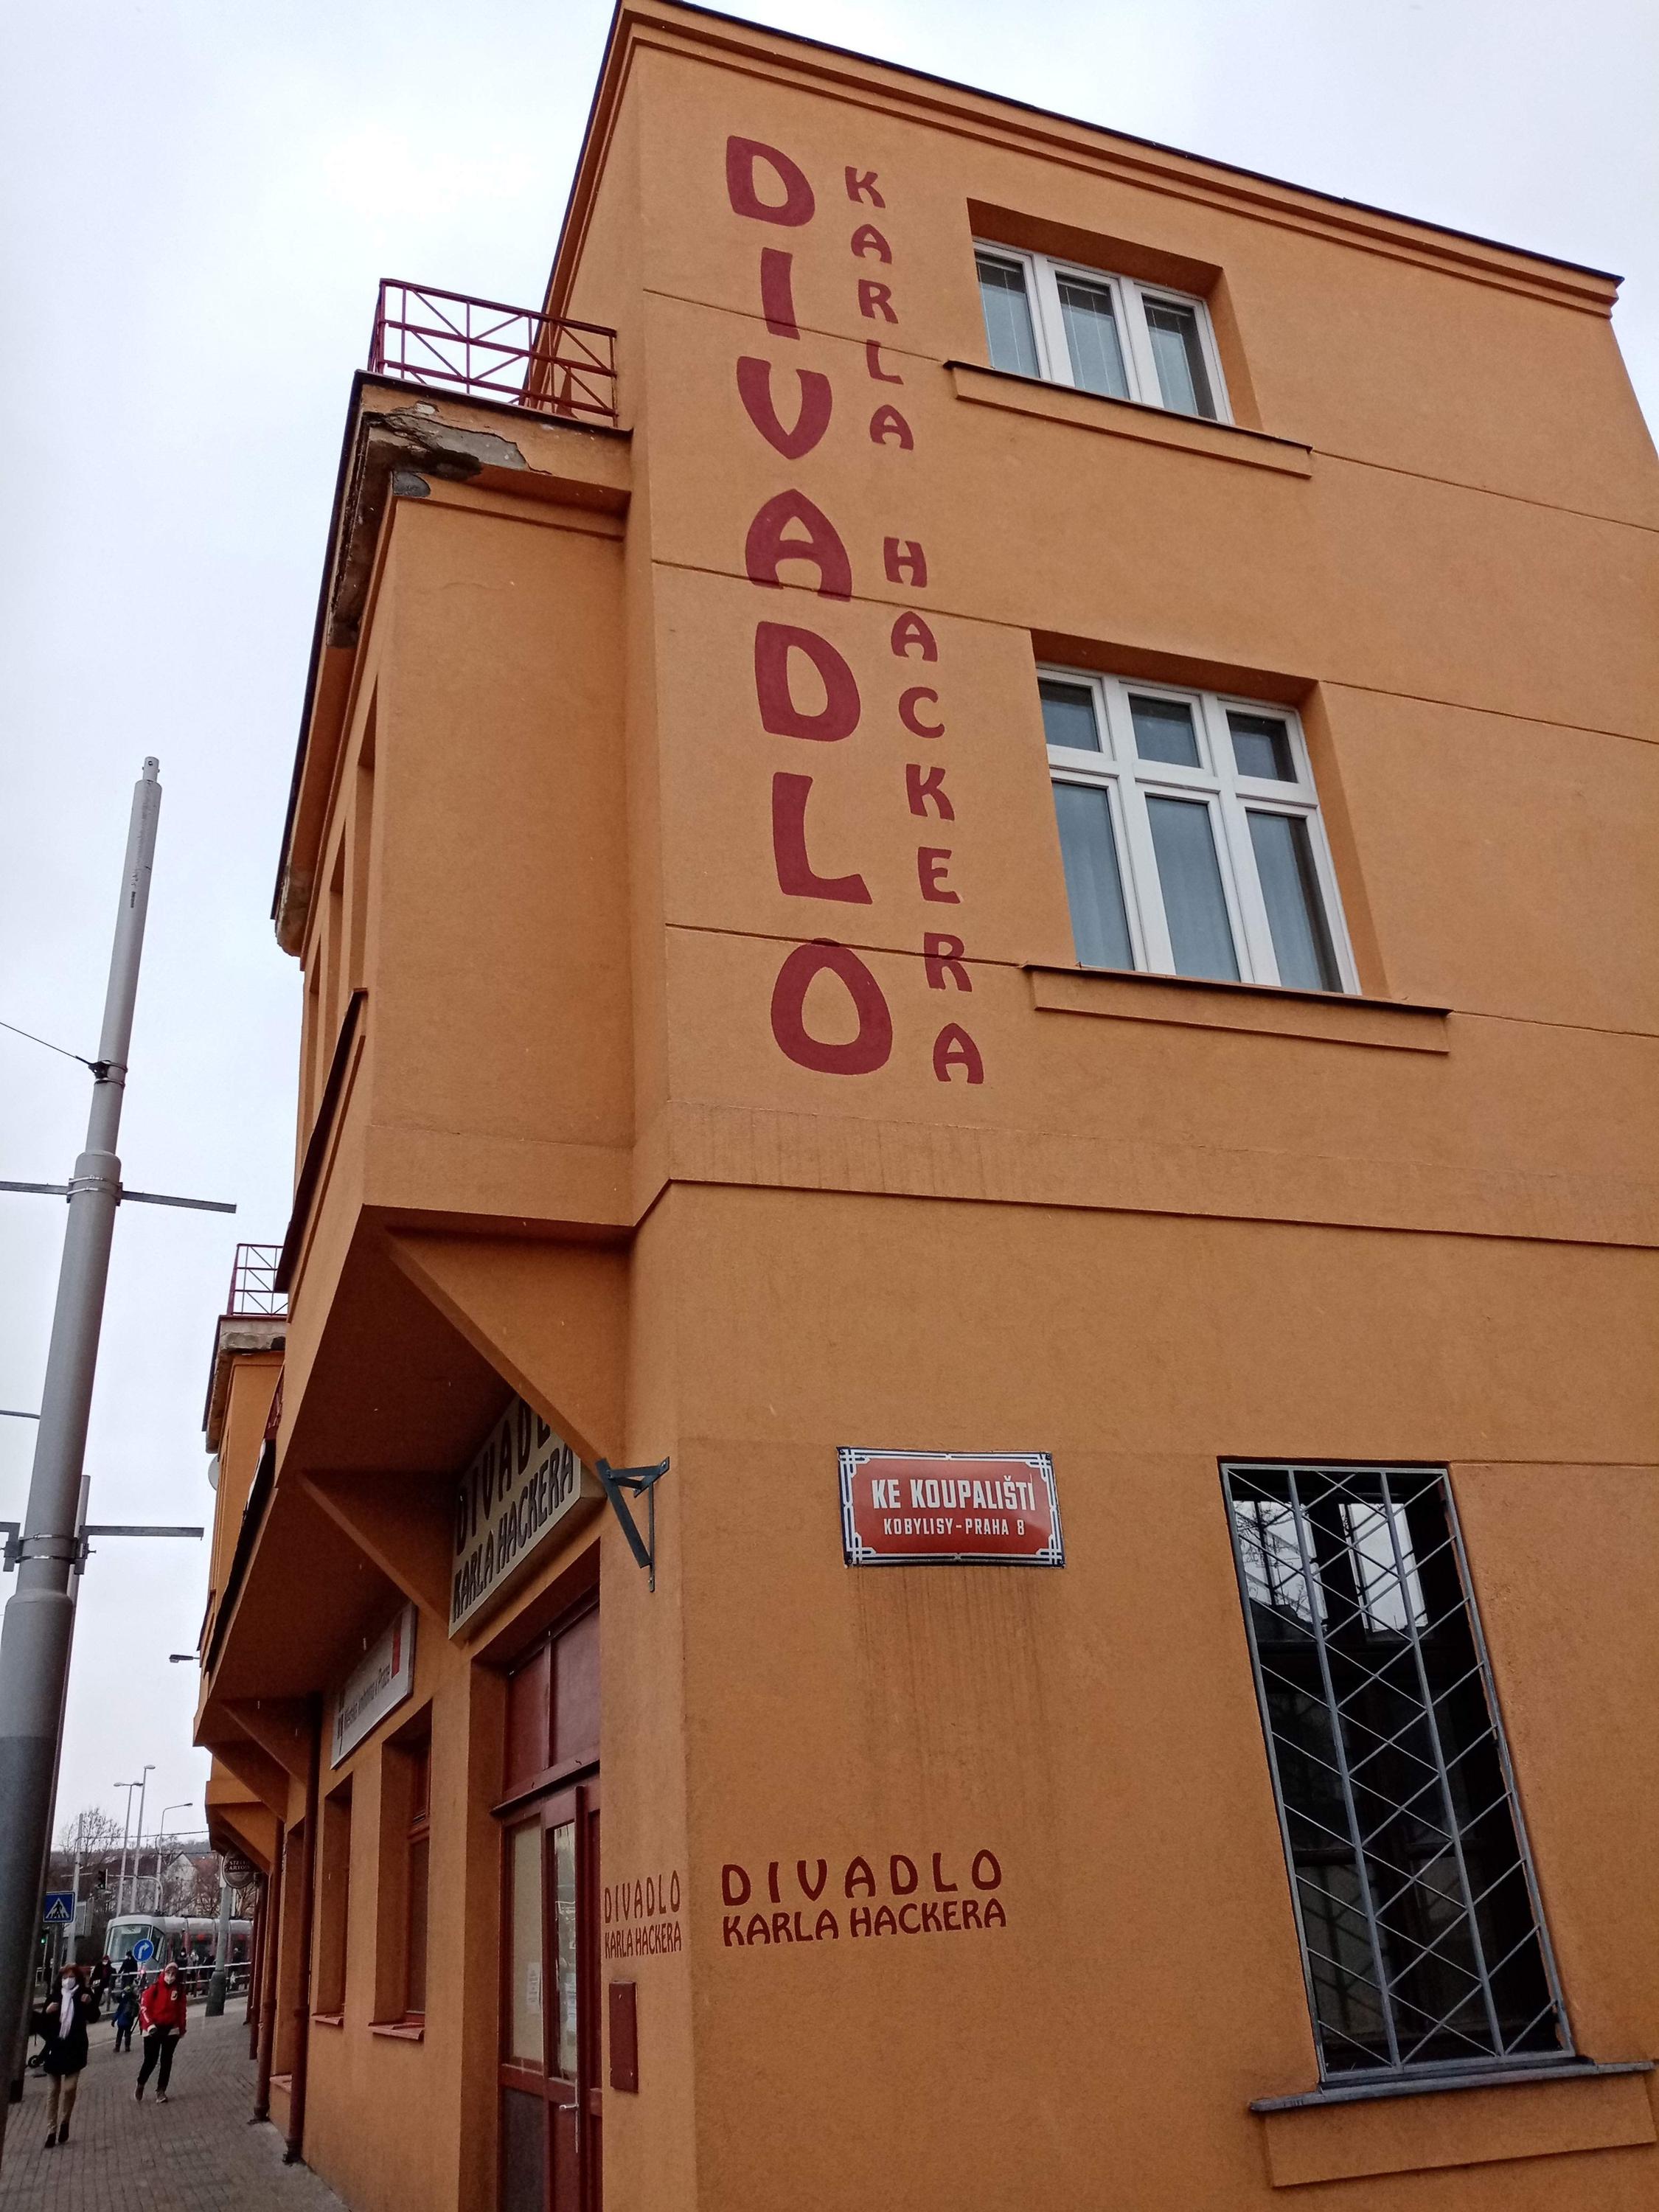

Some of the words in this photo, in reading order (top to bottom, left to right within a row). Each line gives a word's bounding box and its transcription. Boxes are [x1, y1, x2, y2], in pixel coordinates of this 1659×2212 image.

[726, 135, 893, 1076] DIVADLO
[845, 165, 914, 451] KARLA
[883, 536, 984, 1085] HACKERA
[456, 1397, 552, 1557] DIVADL
[872, 1479, 901, 1509] KE
[910, 1475, 1035, 1511] KOUPALIŠTI
[452, 1530, 494, 1623] KARLA
[496, 1442, 574, 1575] HACKERA
[1016, 1519, 1025, 1536] 8
[605, 1870, 681, 1924] DIVADLO
[721, 1848, 1002, 1906] DIVADLO
[605, 1928, 633, 1959] KARLA
[635, 1921, 681, 1956] HACKERA
[722, 1909, 839, 1947] KARLA
[849, 1898, 1006, 1938] HACKERA
